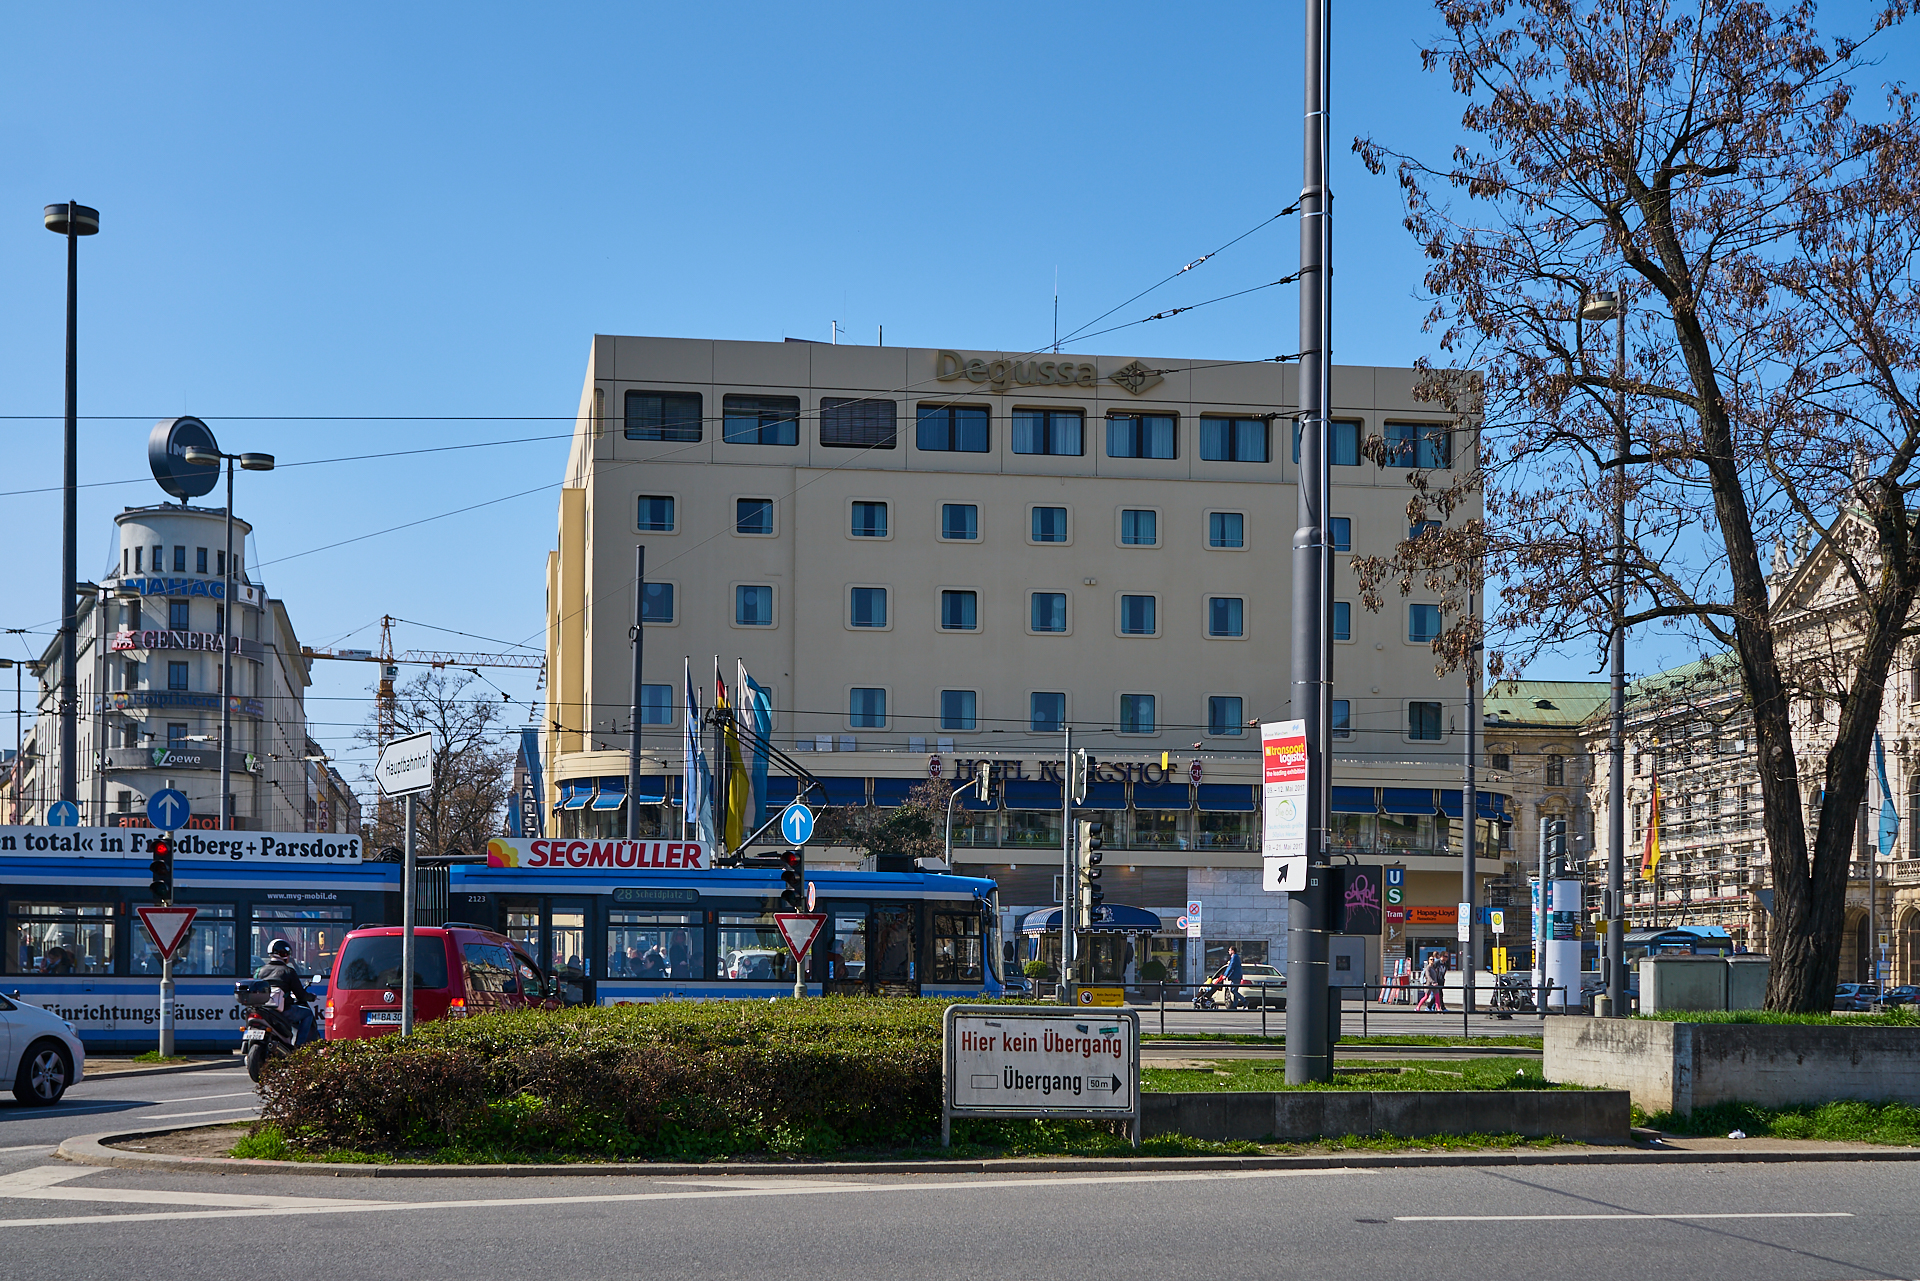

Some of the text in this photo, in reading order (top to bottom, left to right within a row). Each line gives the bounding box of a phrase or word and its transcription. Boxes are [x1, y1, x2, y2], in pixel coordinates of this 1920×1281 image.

[937, 350, 1096, 392] Degussa
[125, 578, 226, 599] MAHAG
[133, 691, 220, 708] Hofpfisterei
[1272, 743, 1305, 755] transport
[158, 750, 201, 767] Loewe
[385, 750, 429, 779] Hauptbahnhof
[1280, 752, 1305, 765] logistic
[1295, 784, 1305, 792] 2017
[1286, 808, 1293, 816] 66
[119, 815, 235, 830] ann hotl
[0, 836, 17, 850] n
[100, 833, 124, 852] in
[131, 833, 243, 861] Frdberg
[246, 844, 257, 856] +
[261, 836, 358, 859] Parsdorf
[528, 840, 702, 869] SEGMÜLLER
[1389, 870, 1401, 884] U
[267, 892, 337, 901] www.mvg-mobil.de
[617, 889, 633, 900] 28
[635, 889, 683, 900] Scheidplatz
[1388, 888, 1401, 904] S
[1417, 909, 1455, 917] Hapag-Lloyd
[961, 1029, 1122, 1058] Hier kein Übergang
[1003, 1066, 1082, 1095] Übergang
[1090, 1079, 1100, 1088] 50
